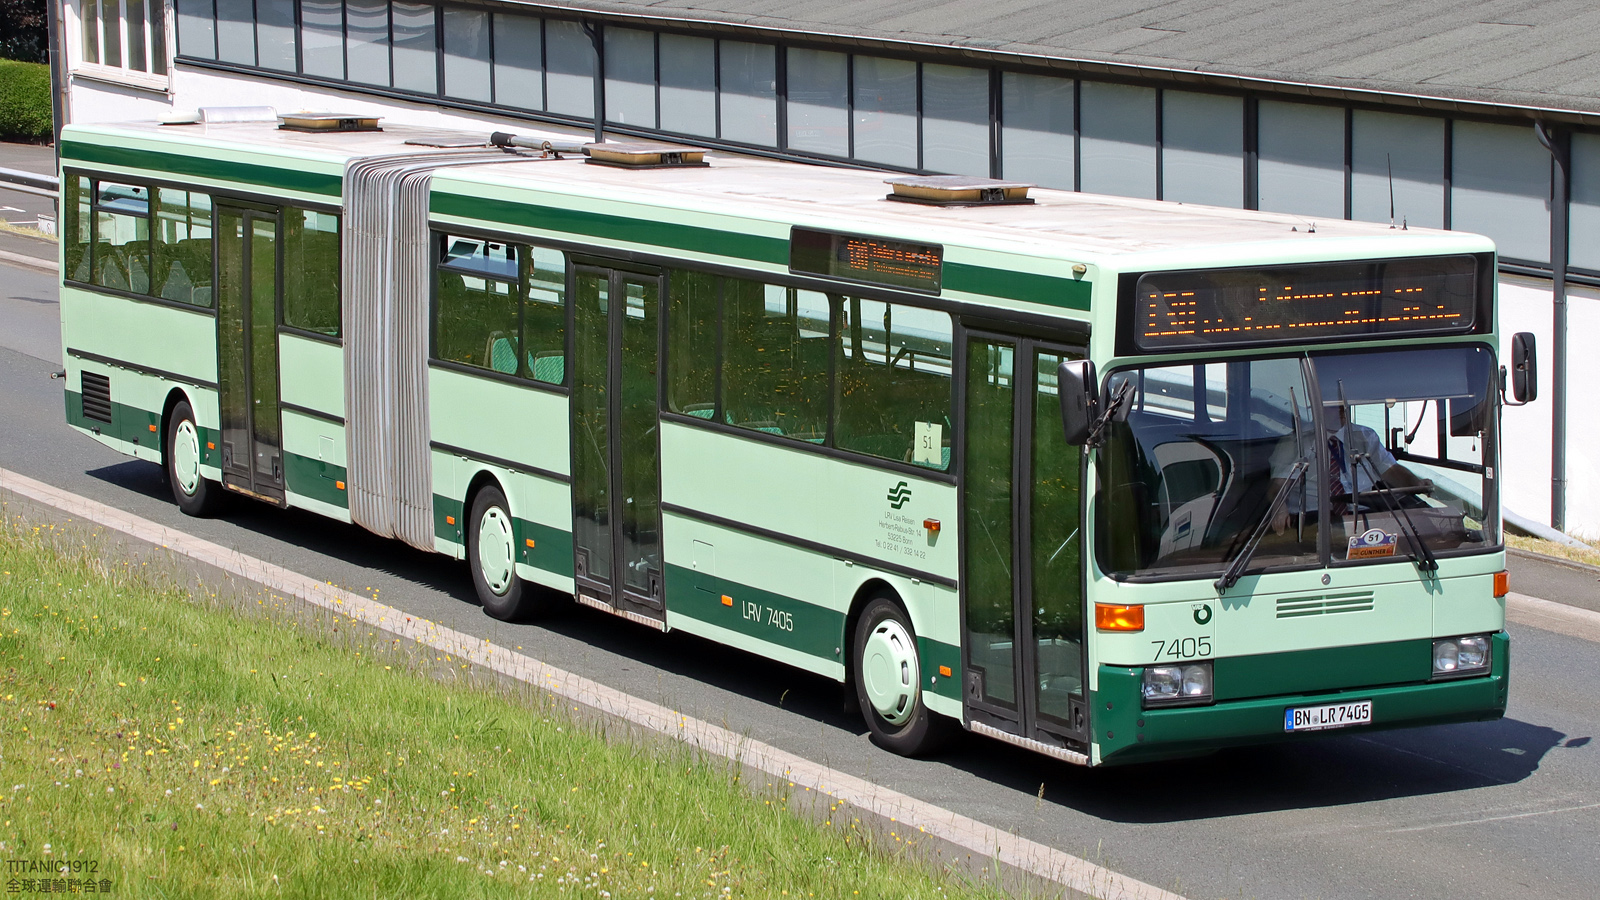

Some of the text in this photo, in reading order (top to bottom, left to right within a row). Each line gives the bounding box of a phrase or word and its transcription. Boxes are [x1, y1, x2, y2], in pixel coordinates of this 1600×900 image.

[923, 435, 932, 449] 51
[916, 529, 921, 537] 14
[1368, 533, 1379, 542] 51
[902, 536, 913, 545] Bonn
[893, 544, 899, 552] 41
[904, 546, 913, 556] 332
[920, 550, 926, 559] 22
[742, 600, 793, 632] LRV 7405
[1151, 636, 1212, 661] 7405
[1295, 709, 1310, 726] BN
[1320, 707, 1336, 723] LR
[1339, 704, 1369, 722] 7405
